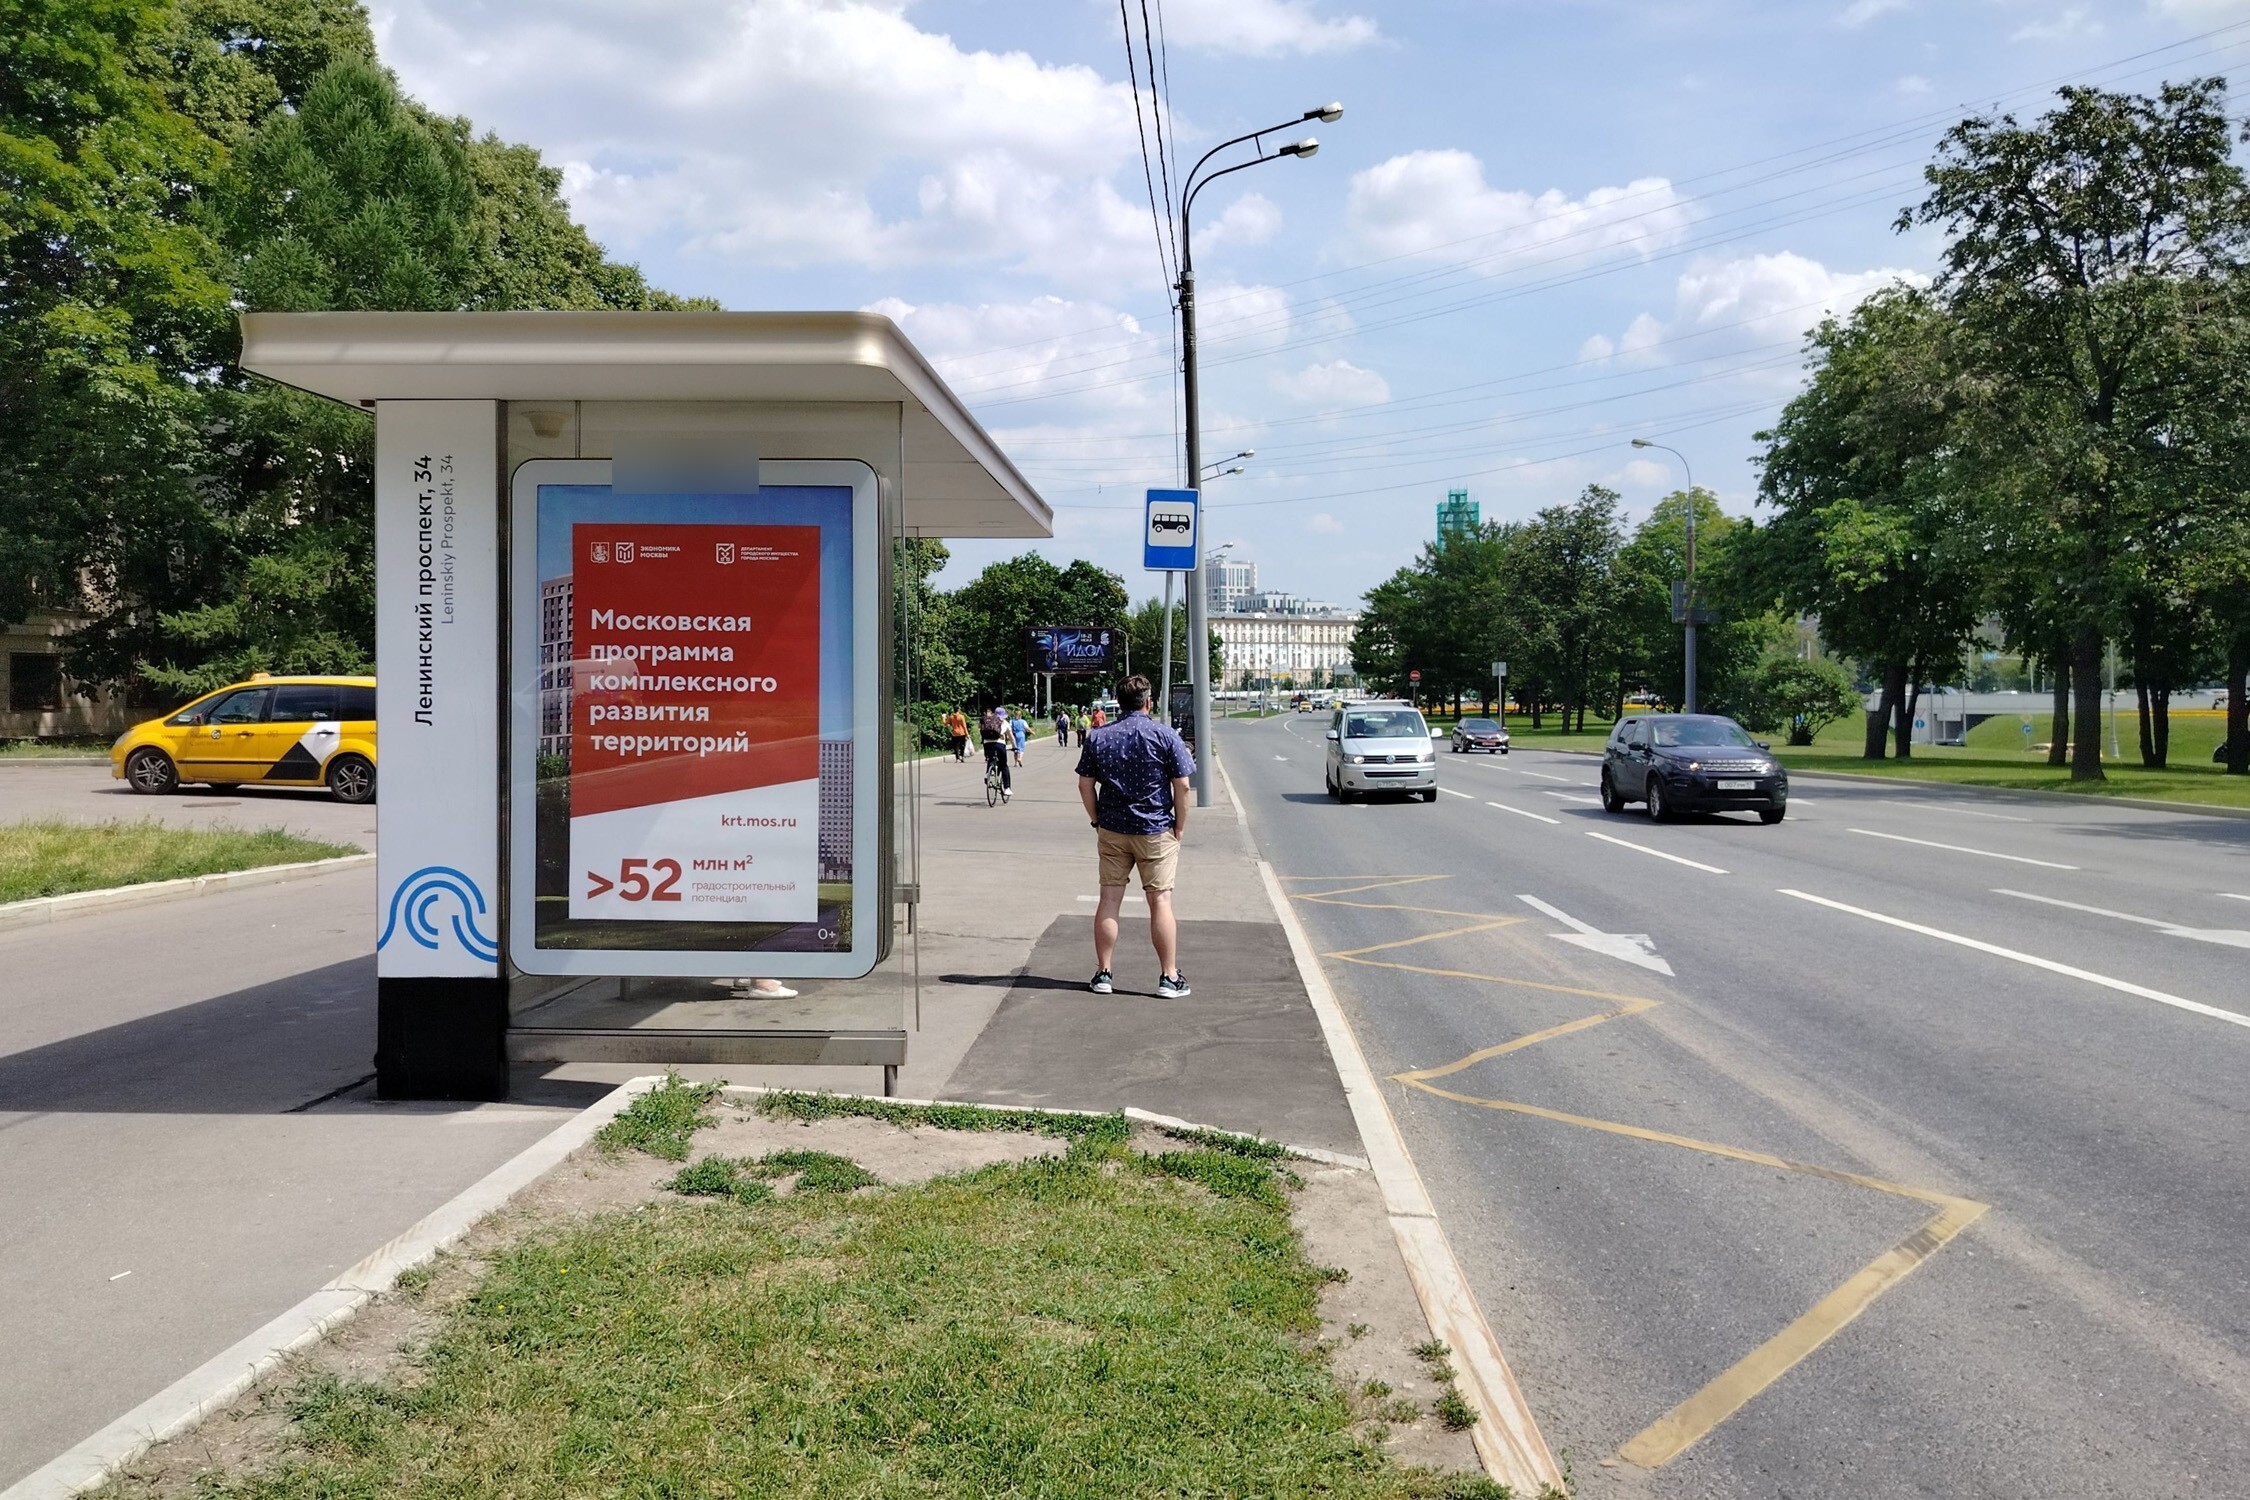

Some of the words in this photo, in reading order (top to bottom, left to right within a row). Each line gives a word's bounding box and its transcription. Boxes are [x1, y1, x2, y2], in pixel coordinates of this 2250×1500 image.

[414, 454, 433, 483] 34
[440, 454, 454, 474] 34
[440, 478, 456, 549] Prospekt,
[418, 488, 437, 596] проспект,
[440, 553, 457, 624] Leninskiy
[591, 608, 752, 632] Московская
[590, 644, 734, 667] программа
[1067, 644, 1105, 657] ИДОЛ
[414, 602, 433, 727] Ленинский
[590, 674, 778, 693] комплексного
[590, 705, 709, 726] развития
[591, 730, 749, 758] территорий
[721, 814, 797, 829] krt.mos.ru
[692, 857, 728, 871] млн
[691, 881, 796, 893] градостроительный
[691, 894, 748, 904] потенциал
[817, 928, 837, 940] 0+
